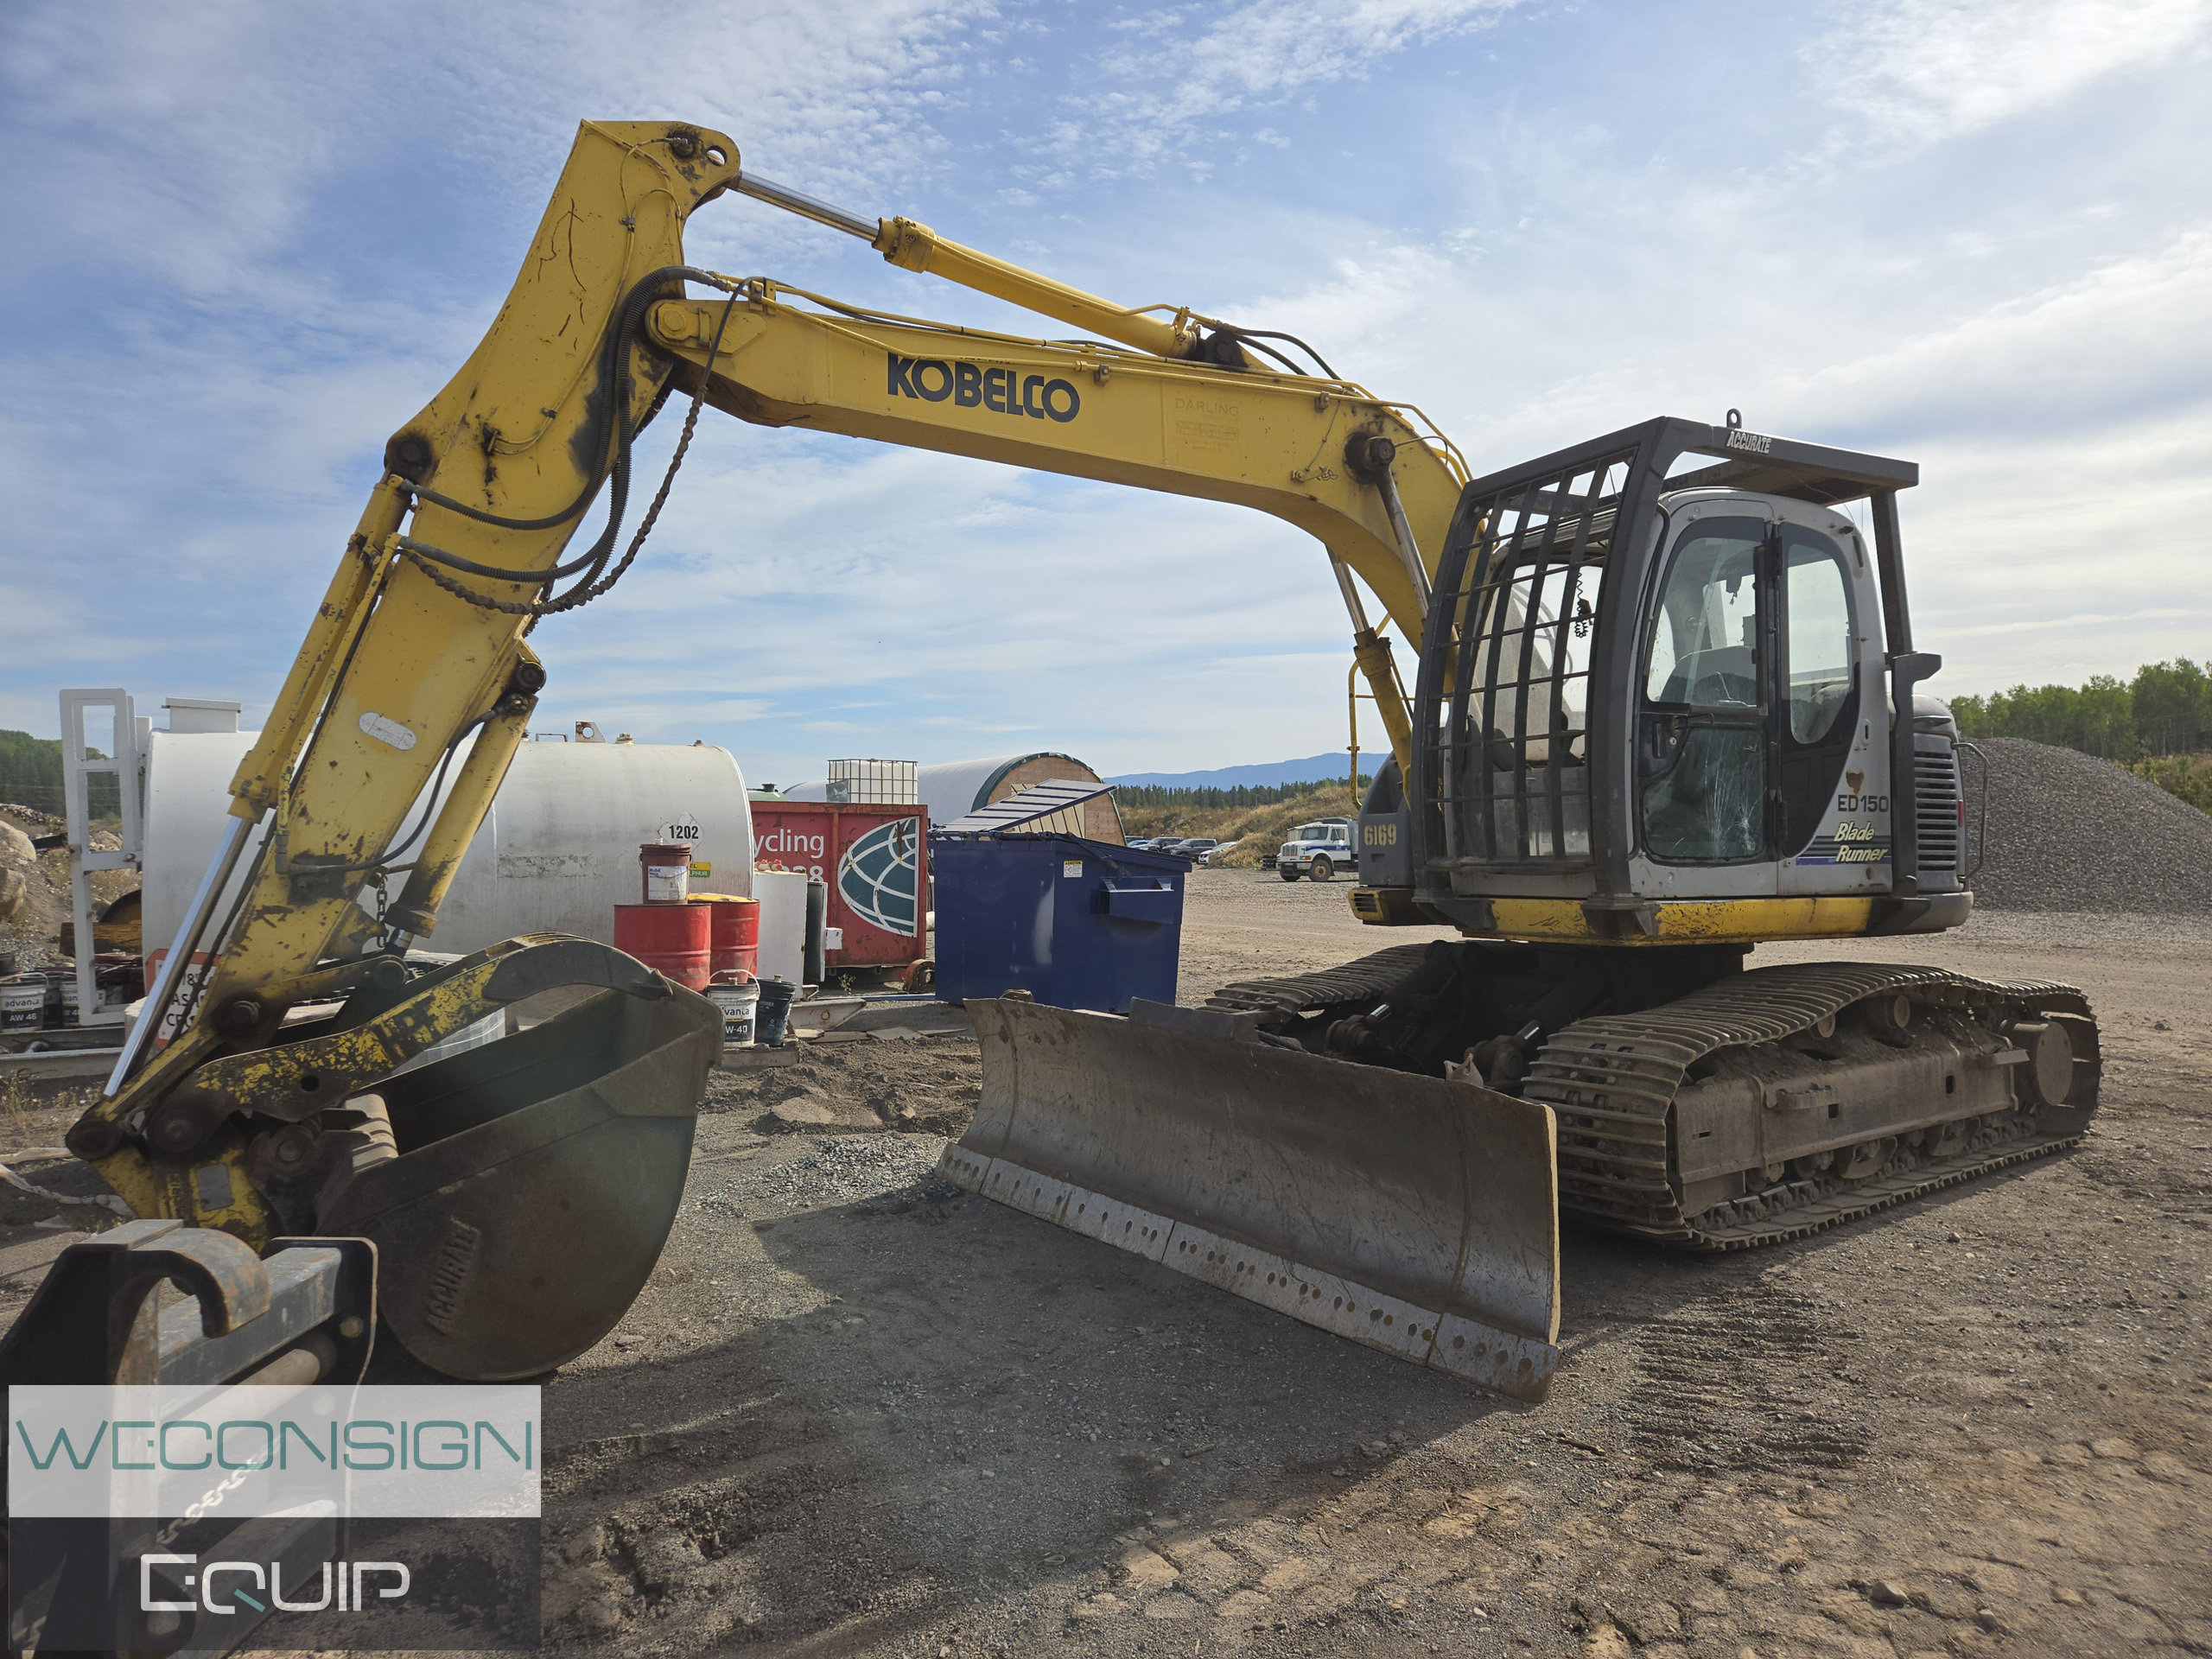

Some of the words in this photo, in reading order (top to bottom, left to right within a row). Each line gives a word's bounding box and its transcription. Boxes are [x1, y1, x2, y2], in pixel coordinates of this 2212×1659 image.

[888, 351, 1080, 423] KOBELCO
[1175, 398, 1239, 416] DARLING
[1726, 431, 1771, 454] ACCURATE
[669, 824, 699, 839] 1202
[1364, 823, 1397, 846] 6169
[1834, 821, 1875, 842] Blade
[753, 829, 824, 859] ycling
[1835, 844, 1889, 862] Runner
[426, 1216, 480, 1337] ACCURATE
